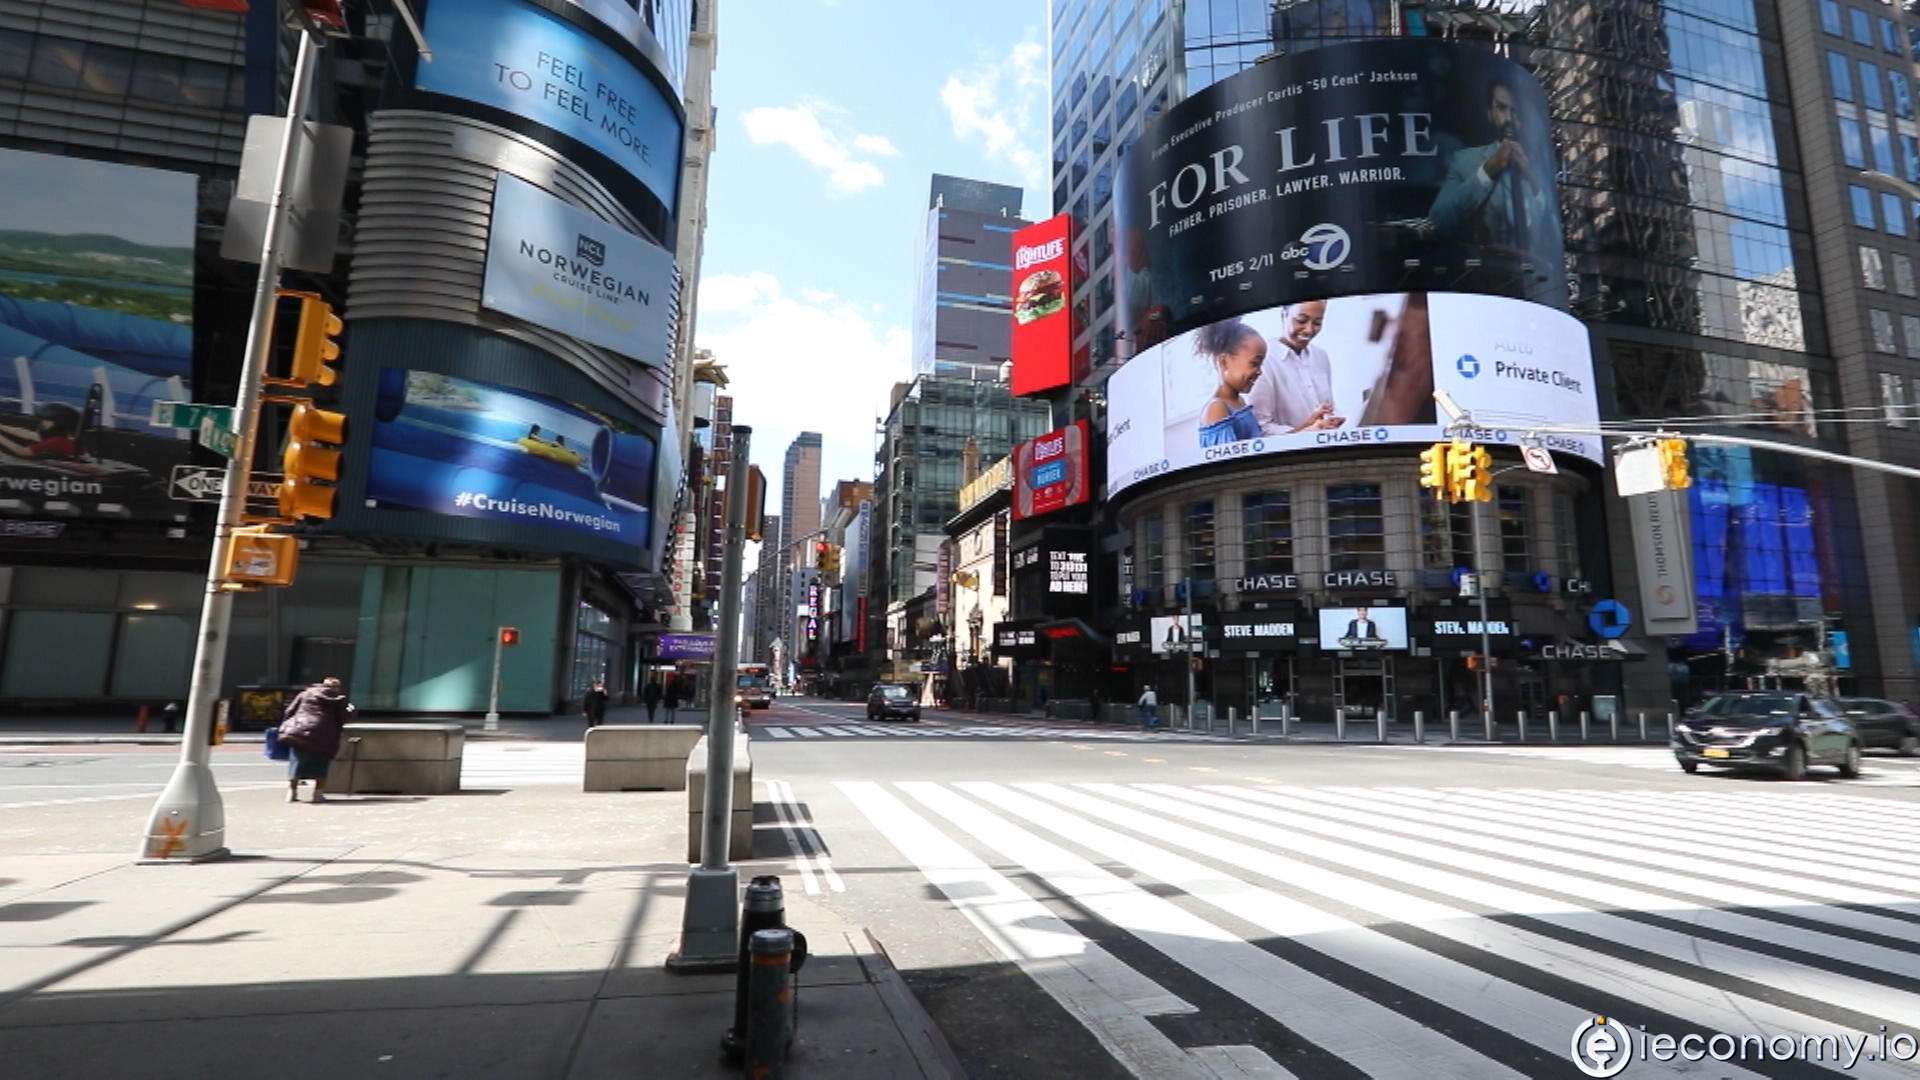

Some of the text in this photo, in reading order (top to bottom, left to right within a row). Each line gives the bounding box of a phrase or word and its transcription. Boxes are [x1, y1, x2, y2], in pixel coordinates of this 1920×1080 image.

[494, 63, 532, 91] TO
[544, 83, 593, 122] FEEL
[537, 51, 637, 126] FEEL FREE
[1170, 118, 1212, 146] Executive
[1215, 96, 1264, 121] Producer
[1267, 84, 1303, 103] Curtis
[1369, 70, 1418, 83] Jackson
[1148, 112, 1439, 231] FOR LIFE
[1168, 166, 1406, 238] FATHER. PRISONER. LAWYER. WARRIOR.
[519, 239, 650, 306] NORWEGIAN
[1209, 261, 1245, 282] TUES
[1249, 253, 1274, 272] 2/11
[1281, 247, 1310, 261] abc
[553, 271, 619, 304] CRUISE LINE
[1495, 361, 1583, 394] Private Client
[1204, 442, 1250, 461] CHASE
[1315, 430, 1372, 445] CHASE
[1546, 434, 1579, 450] CHASE
[188, 476, 225, 492] ONE
[454, 490, 622, 533] #CruiseNorwegian
[1651, 525, 1669, 578] THOMSON
[1234, 574, 1297, 592] CHASE
[1324, 571, 1396, 587] CHASE
[808, 584, 818, 640] REGAL
[1223, 623, 1295, 638] STEVE MADDEN
[1542, 644, 1611, 660] CHASE
